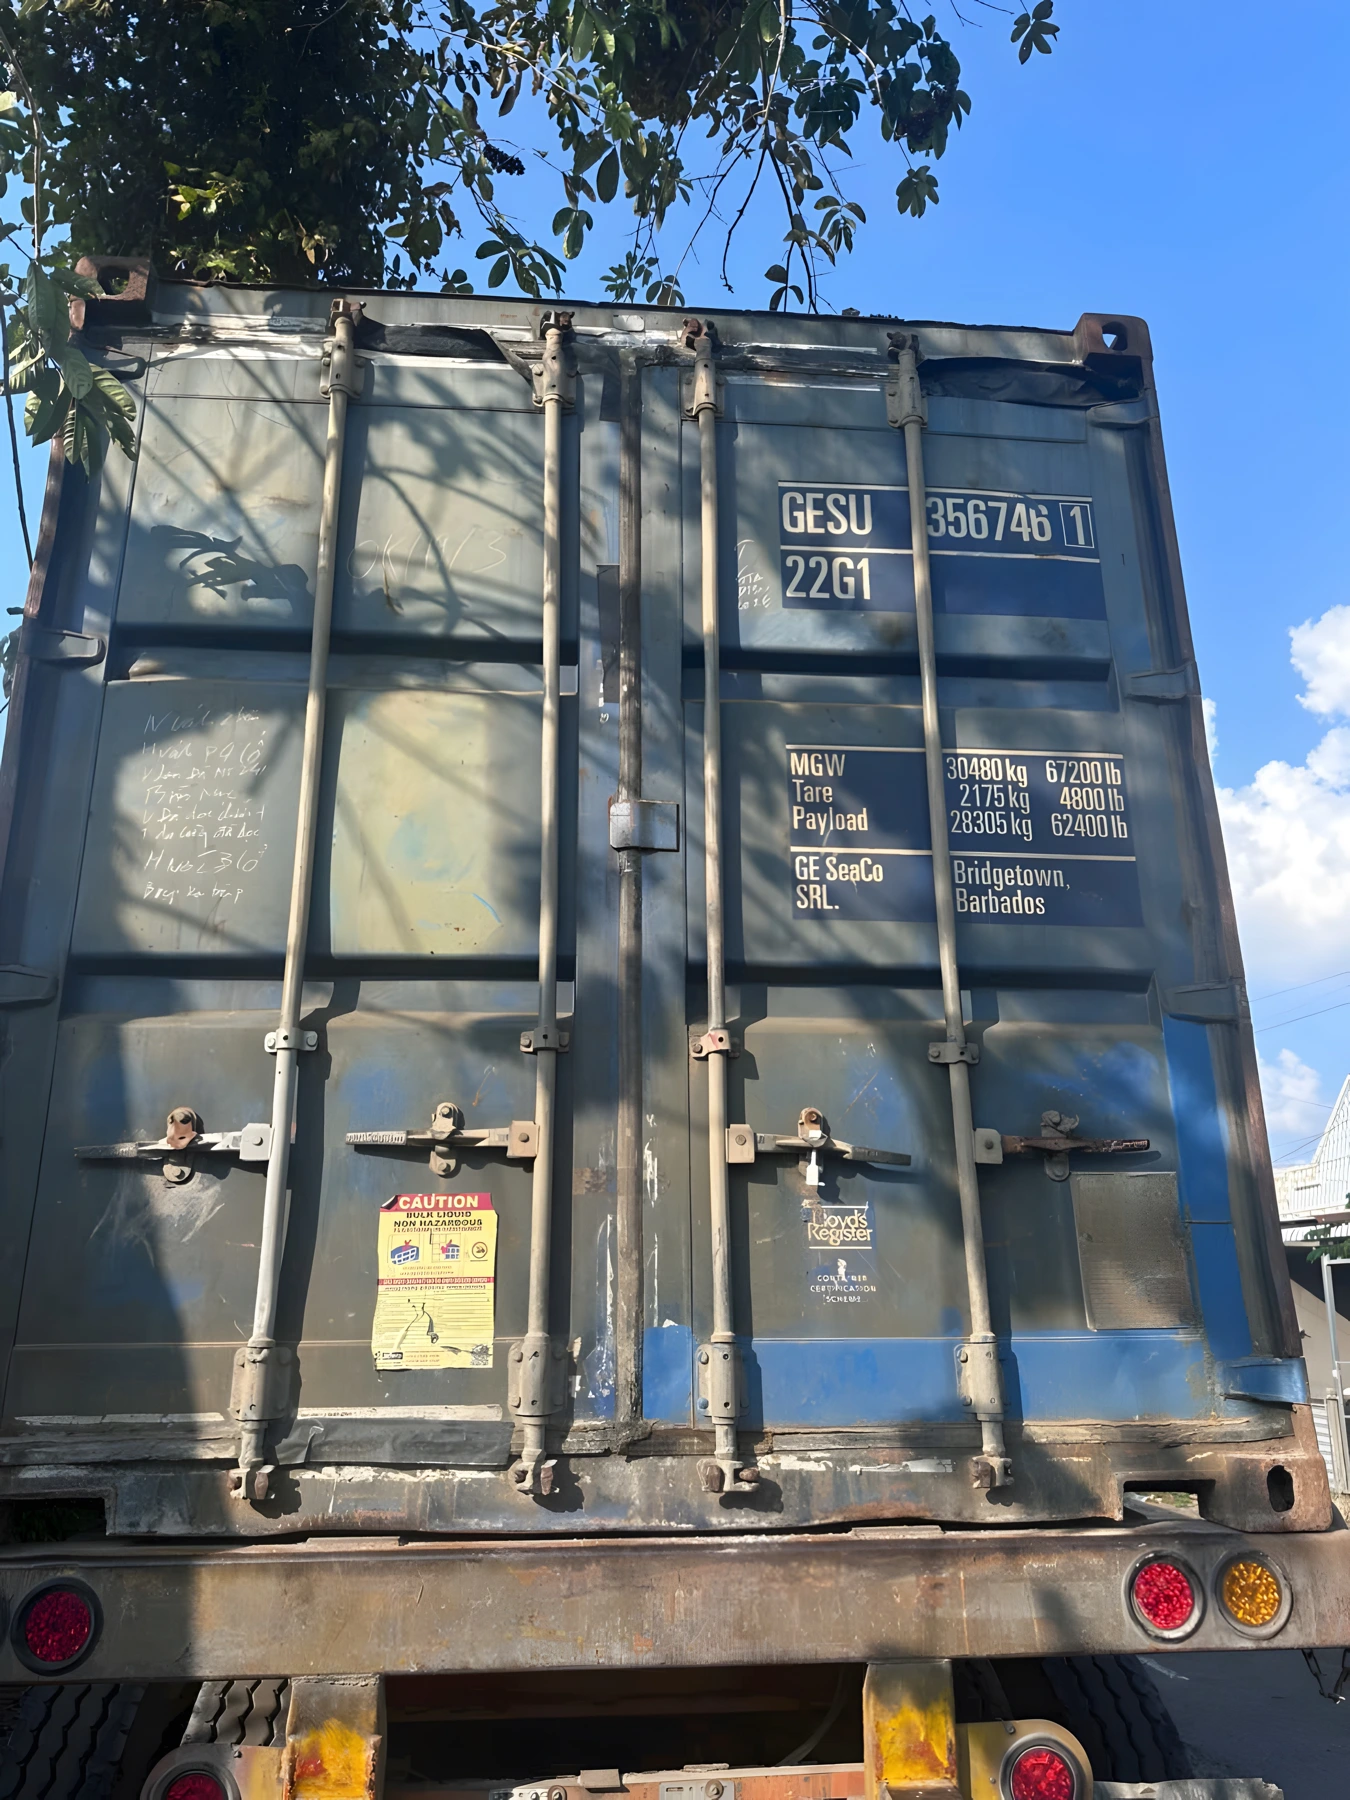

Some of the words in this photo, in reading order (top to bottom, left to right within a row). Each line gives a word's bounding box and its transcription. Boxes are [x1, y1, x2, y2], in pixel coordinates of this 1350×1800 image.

[782, 491, 873, 535] GESU
[925, 497, 1052, 542] 356746
[1070, 506, 1085, 545] 1
[785, 555, 871, 600] 22G1
[790, 752, 845, 777] MGW
[946, 757, 1003, 781] 30480
[1005, 758, 1027, 788] kg
[1045, 760, 1102, 784] 67200
[1104, 761, 1122, 785] lb
[792, 779, 833, 803] Tare
[960, 783, 1005, 808] 2175
[1008, 785, 1030, 814] kg
[1059, 786, 1105, 811] 4800
[1107, 788, 1125, 812] lb
[792, 805, 869, 836] Payload
[950, 810, 1007, 835] 28305
[1010, 812, 1033, 842] kg
[1051, 813, 1109, 838] 62400
[1110, 815, 1128, 839] lb
[794, 855, 820, 881] GE
[825, 856, 884, 882] SeaCo
[953, 859, 1071, 891] Bridgetown,
[796, 884, 840, 910] SRL.
[955, 887, 1046, 915] Barbados
[398, 1195, 479, 1209] CAUTION
[436, 1210, 472, 1218] LIQUID
[393, 1220, 417, 1228] NON
[419, 1218, 483, 1227] HAZARDOUS
[807, 1222, 873, 1246] Register
